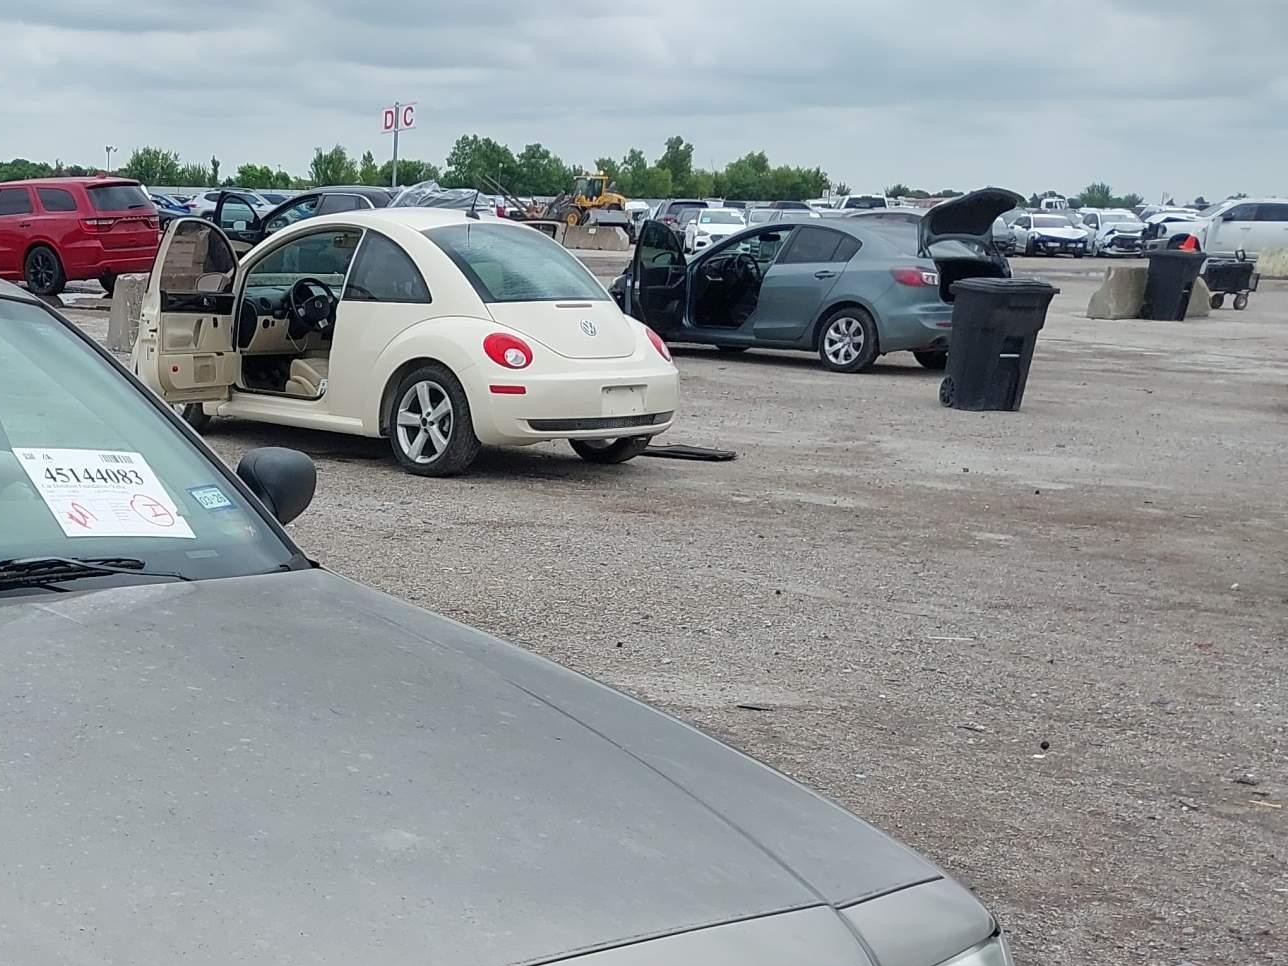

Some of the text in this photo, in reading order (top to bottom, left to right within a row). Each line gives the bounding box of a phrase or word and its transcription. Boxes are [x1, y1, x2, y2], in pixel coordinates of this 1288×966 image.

[384, 110, 394, 129] D
[403, 106, 414, 126] C
[44, 467, 144, 485] 45144083
